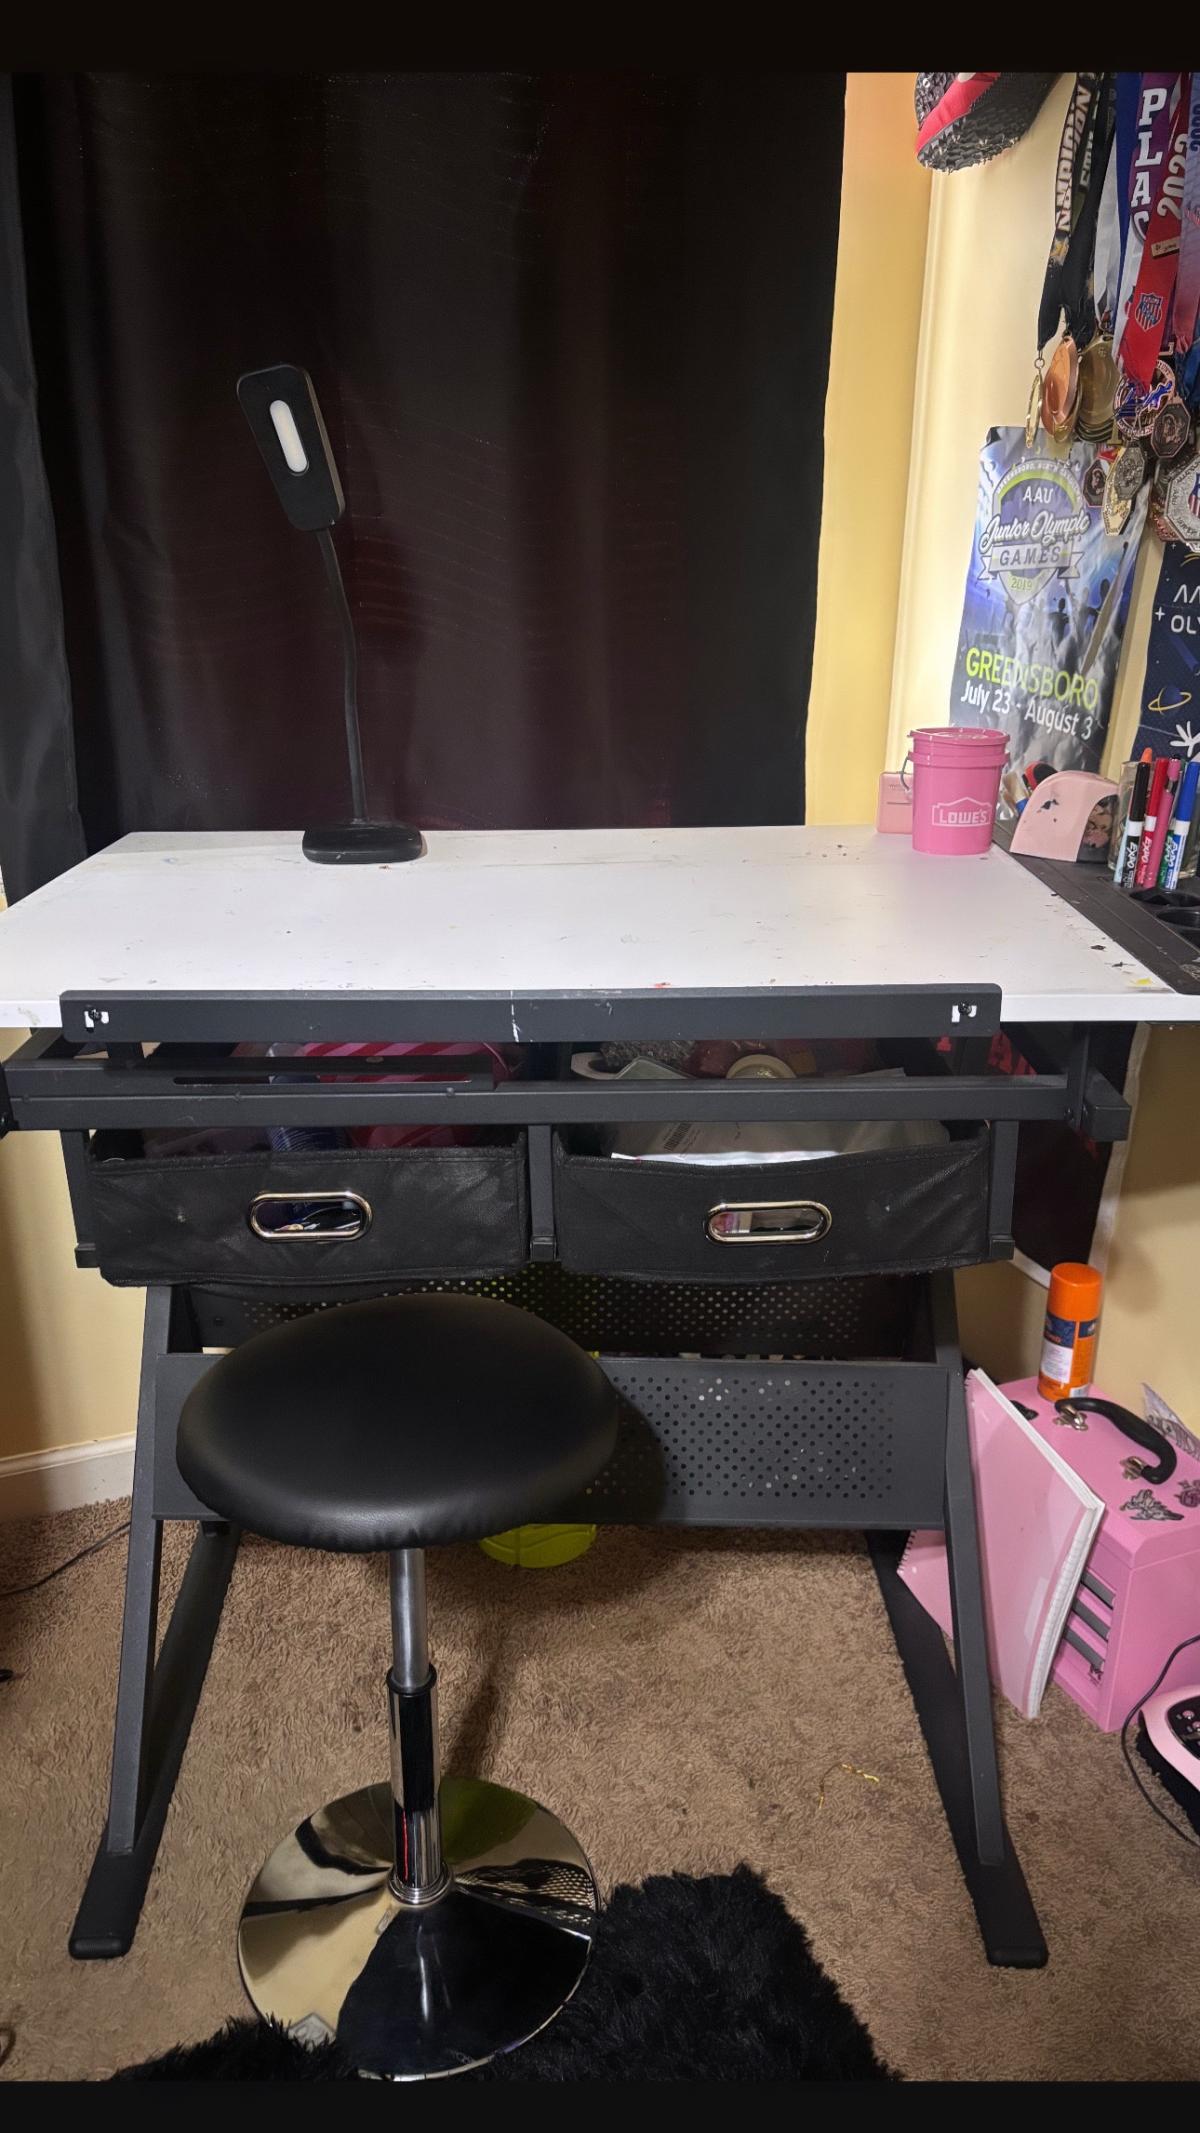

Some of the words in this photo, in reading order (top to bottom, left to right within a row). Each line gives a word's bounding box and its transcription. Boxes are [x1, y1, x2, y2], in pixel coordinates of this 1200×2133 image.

[1022, 486, 1054, 504] AAU
[980, 514, 1030, 554] Junior
[1029, 511, 1091, 546] Olympic
[999, 546, 1062, 566] GAMES
[1010, 576, 1033, 591] 2019
[965, 647, 1099, 710] GREENSBORO
[961, 680, 990, 712] July
[991, 689, 1011, 715] 23
[1024, 697, 1080, 737] August
[1081, 717, 1092, 740] 3
[938, 807, 988, 825] LOWE'S
